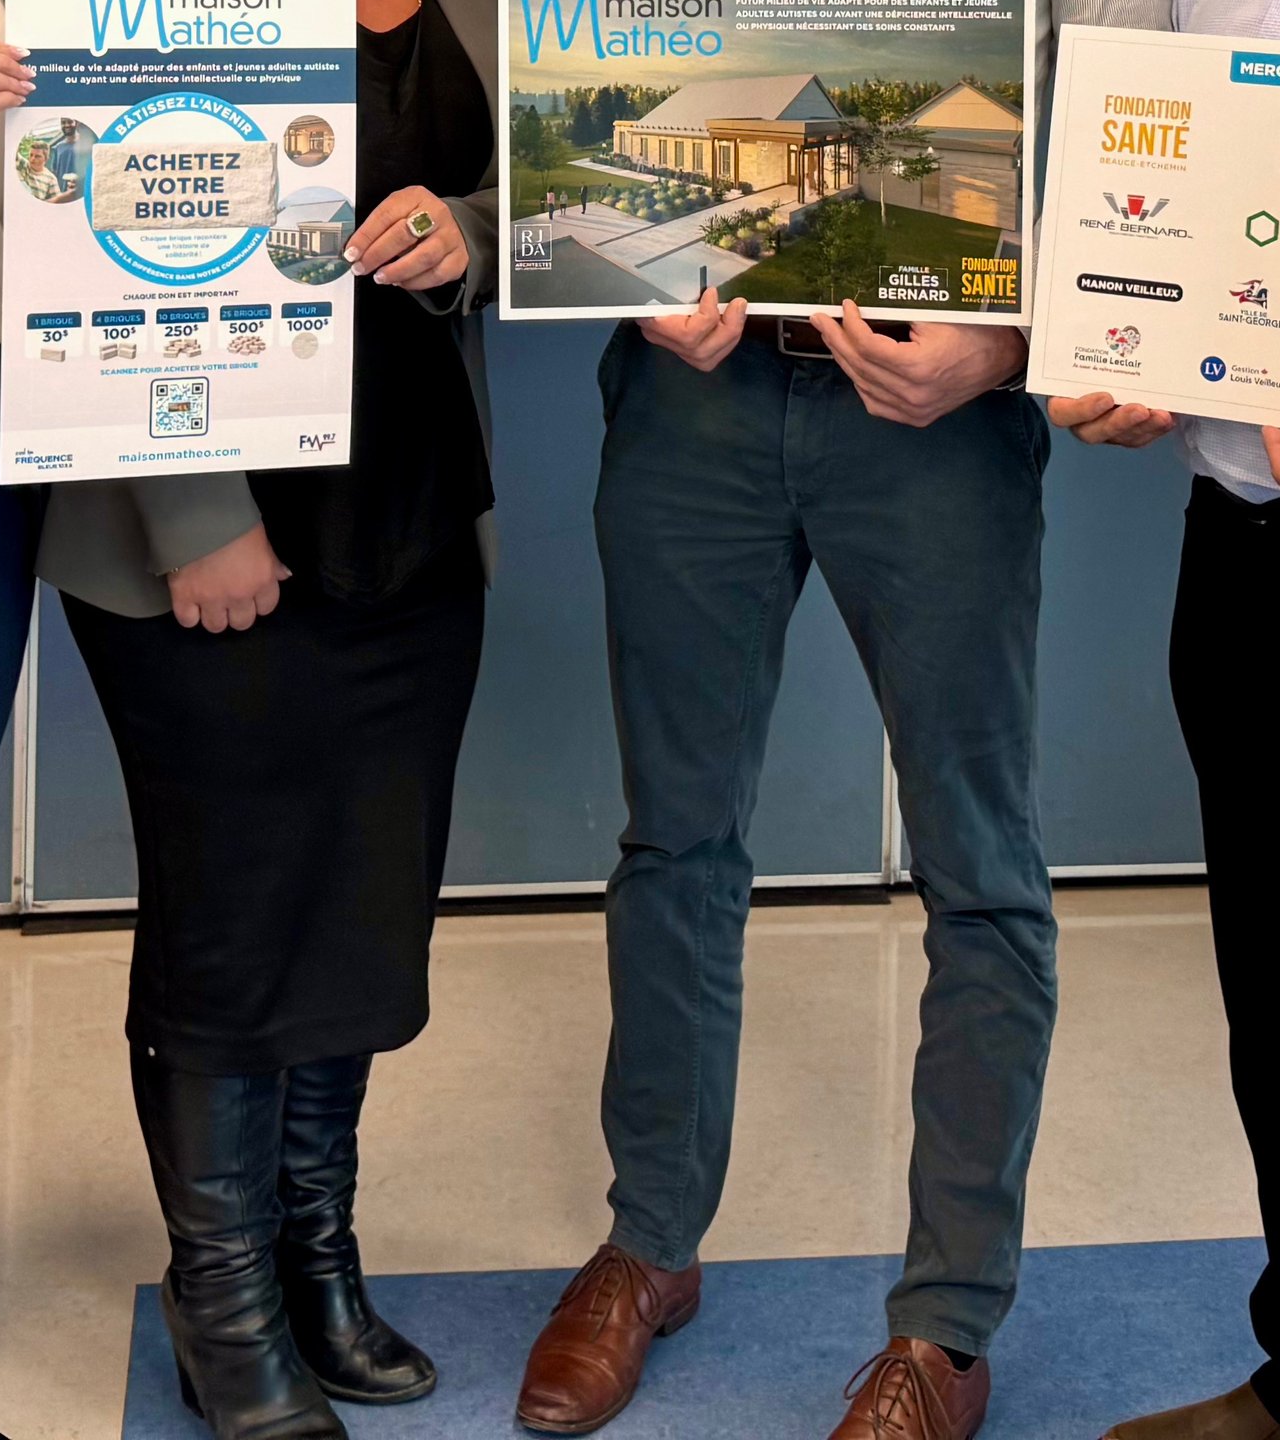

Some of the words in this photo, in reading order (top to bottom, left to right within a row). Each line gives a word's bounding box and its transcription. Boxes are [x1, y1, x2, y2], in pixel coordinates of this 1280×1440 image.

[1104, 94, 1192, 120] FONDATION
[115, 97, 186, 136] BÂTISSEZ
[190, 98, 253, 136] L'AVENIR
[1101, 119, 1190, 160] SANTÉ
[124, 153, 241, 172] ACHETEZ
[141, 177, 224, 195] VOTRE
[135, 200, 230, 219] BRIQUE
[1080, 218, 1116, 230] RENÉ
[1120, 222, 1188, 238] BERNARD
[962, 257, 1016, 272] FONDATION
[889, 274, 939, 287] GILLES
[962, 271, 1016, 296] SANTÉ
[1081, 278, 1123, 292] MANON
[1126, 282, 1180, 298] VEILLEUX
[123, 292, 156, 301] CHAQUE
[178, 291, 192, 299] EST
[194, 290, 239, 298] IMPORTANT
[879, 288, 949, 301] BERNARD
[164, 324, 199, 338] 250$
[228, 321, 264, 334] 500$
[287, 318, 329, 331] 1000$
[42, 330, 69, 343] 30$
[102, 326, 136, 340] 100$
[1074, 352, 1108, 364] Famille
[1109, 358, 1142, 368] Leclair
[1204, 362, 1224, 375] LV
[1232, 364, 1260, 374] Gestion
[1230, 374, 1252, 384] Louis
[118, 447, 241, 462] maisonmatheo.com
